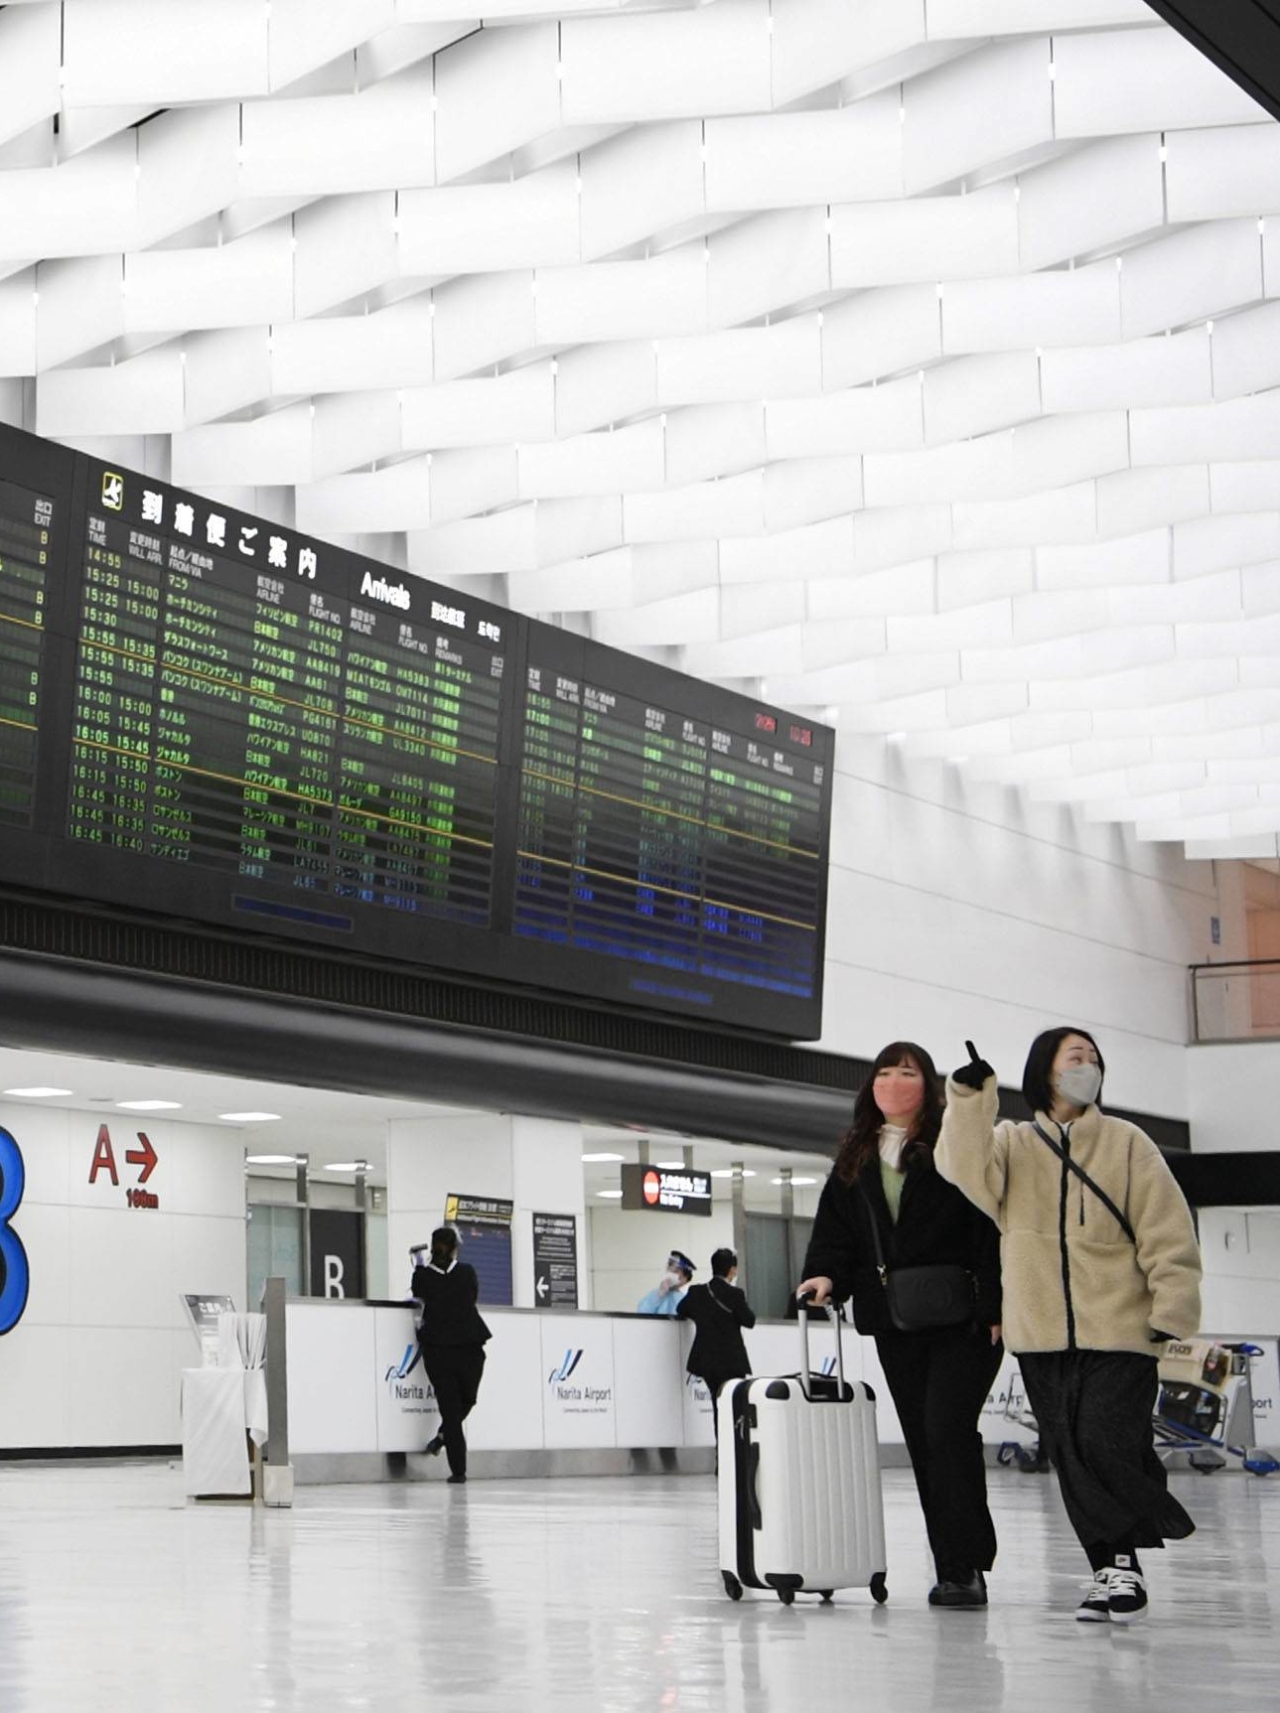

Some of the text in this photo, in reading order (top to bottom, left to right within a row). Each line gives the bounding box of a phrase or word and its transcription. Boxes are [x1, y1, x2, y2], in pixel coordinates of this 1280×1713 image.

[34, 512, 51, 527] EXIT
[89, 530, 106, 546] TIME
[361, 572, 410, 610] Arrivals
[89, 1123, 119, 1186] A
[396, 1386, 423, 1399] Narita
[557, 1387, 611, 1403] Narita Airport
